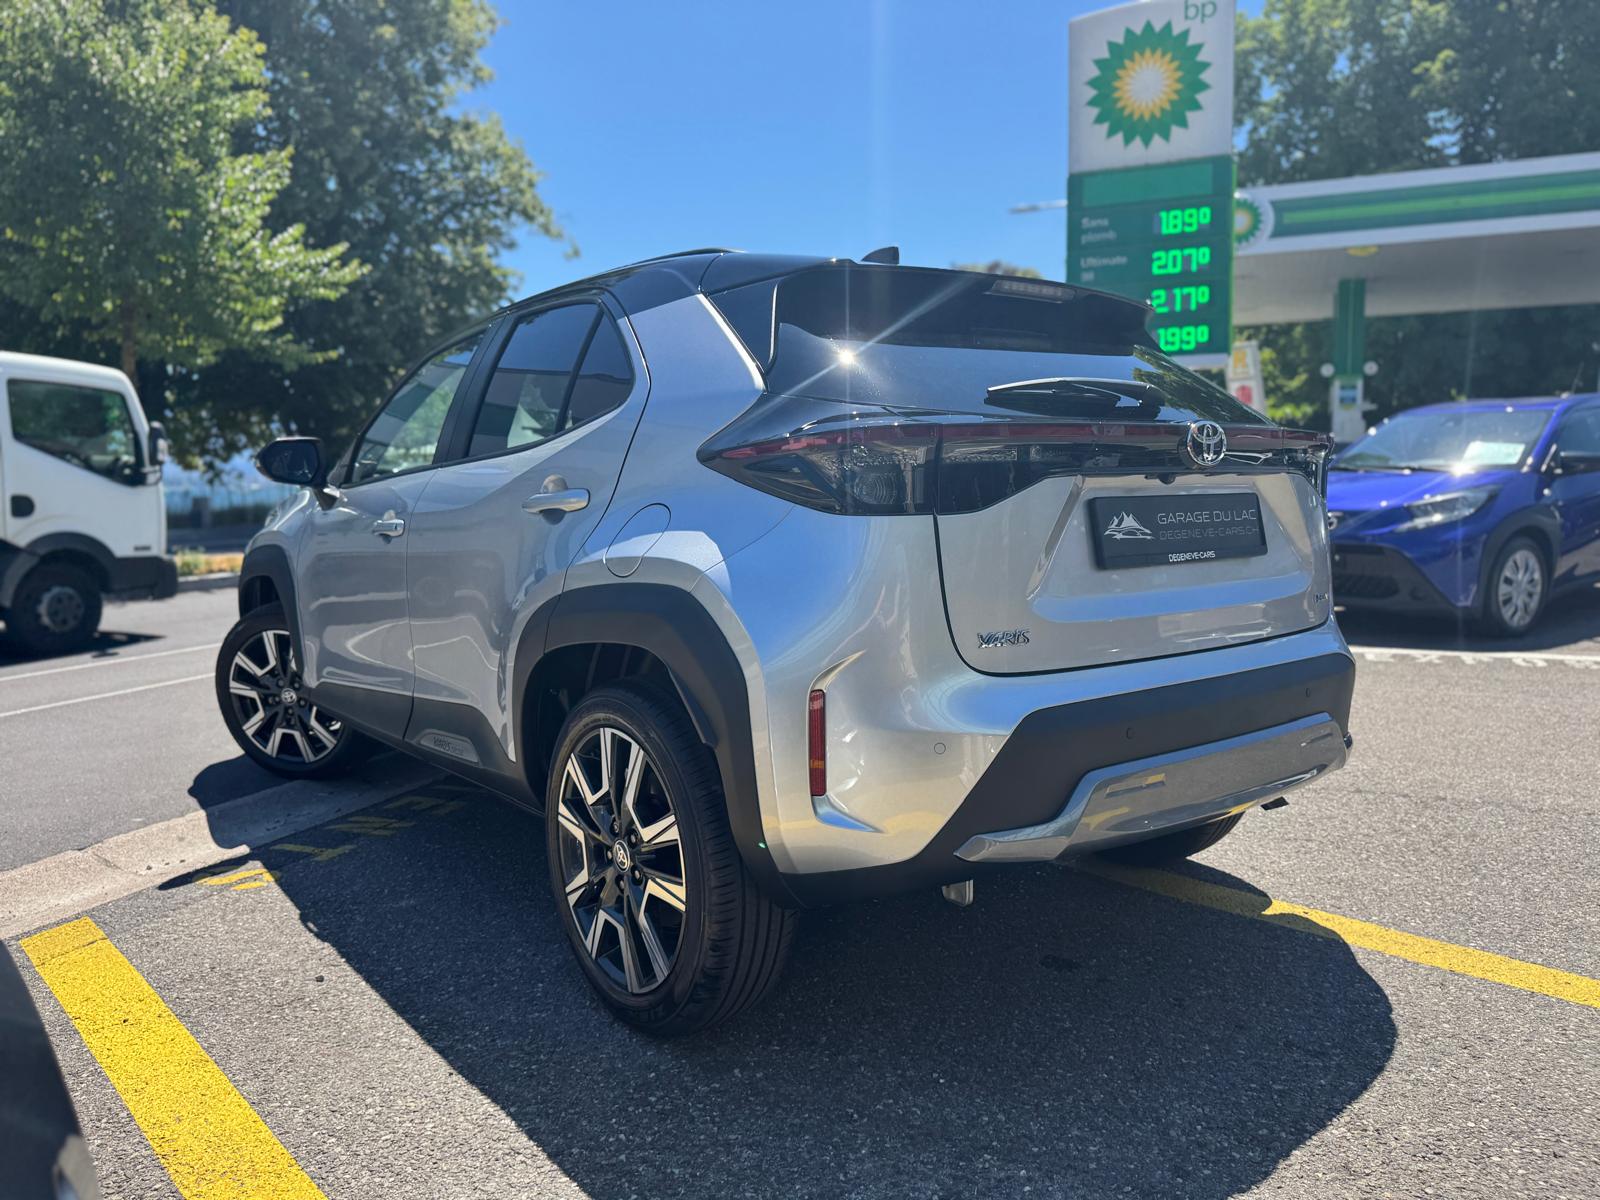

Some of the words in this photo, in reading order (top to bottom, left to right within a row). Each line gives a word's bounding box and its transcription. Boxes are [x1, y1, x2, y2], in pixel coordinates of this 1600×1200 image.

[1184, 0, 1217, 24] bp
[1157, 511, 1211, 525] GARAGE
[1213, 510, 1231, 522] DU
[1233, 509, 1257, 521] LAC
